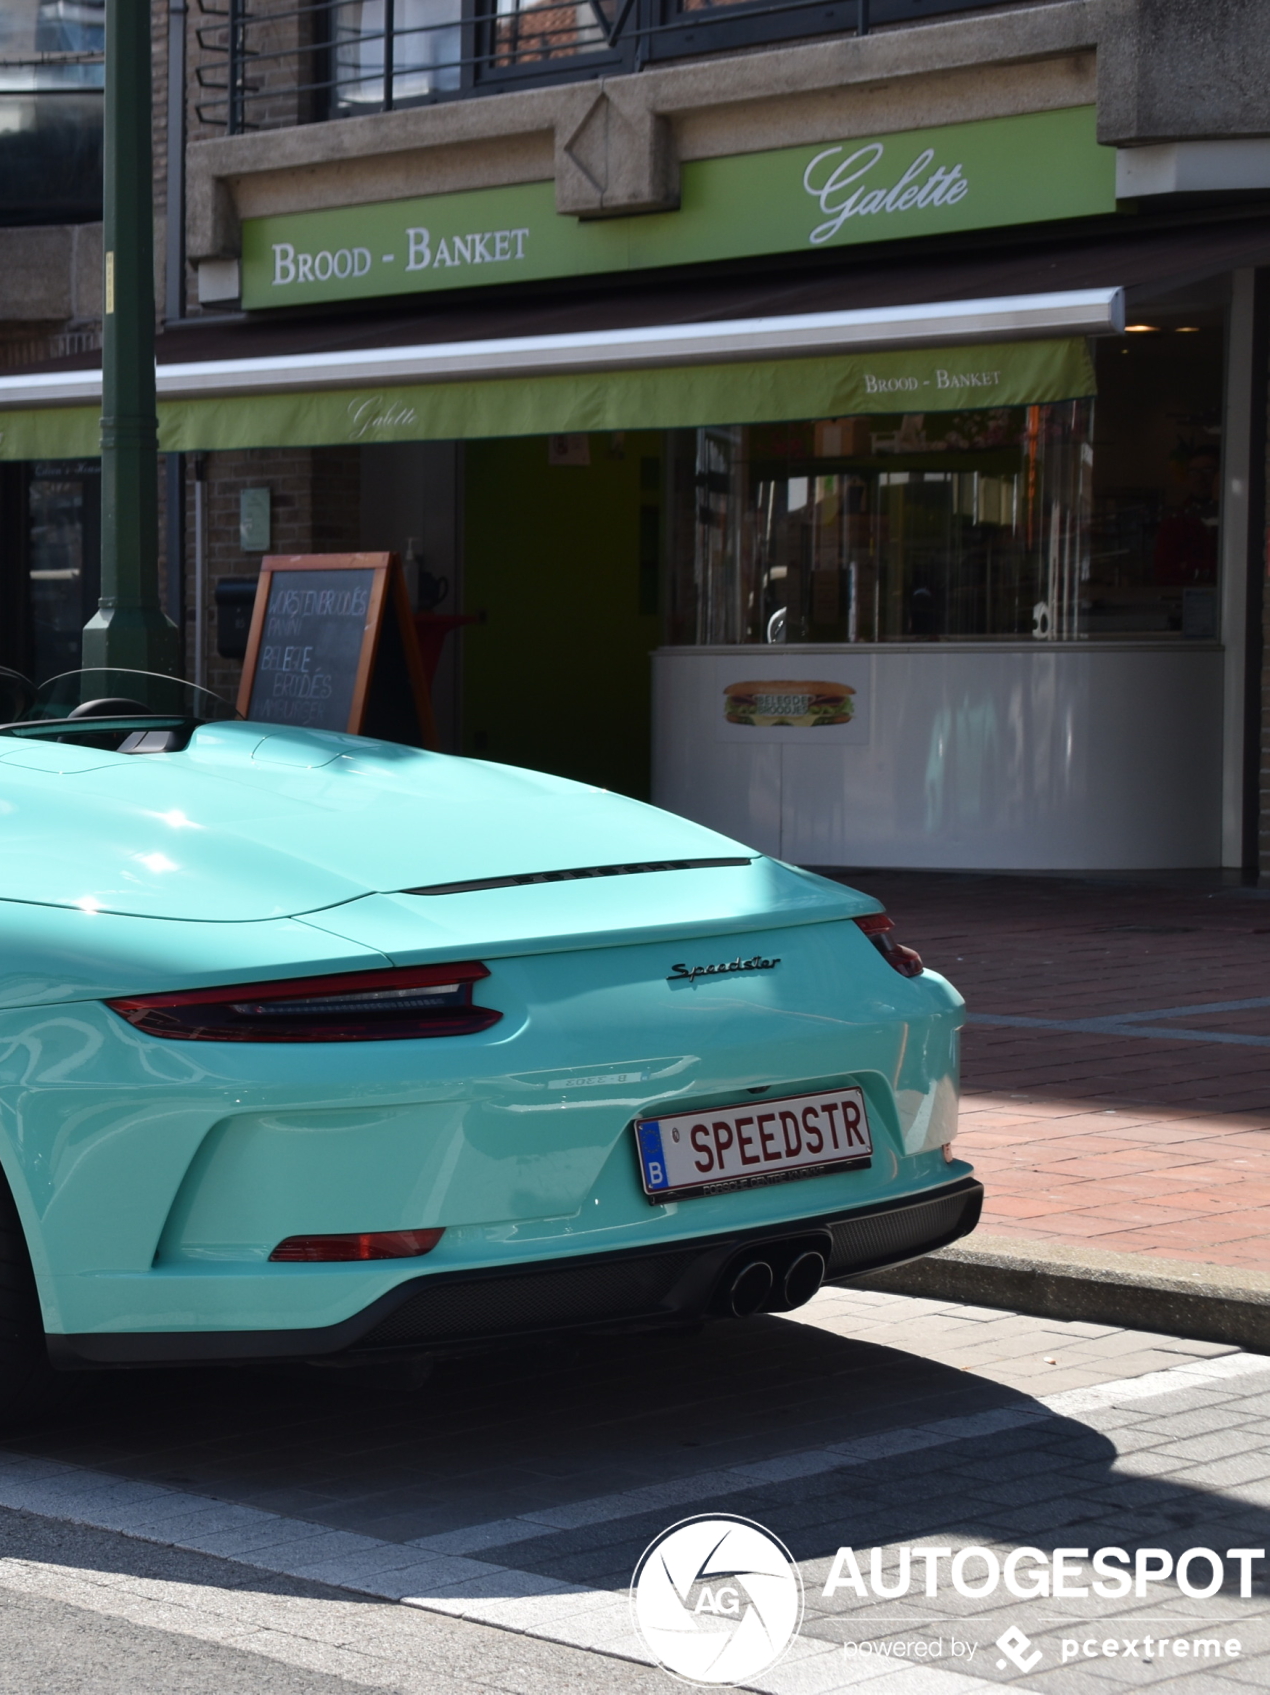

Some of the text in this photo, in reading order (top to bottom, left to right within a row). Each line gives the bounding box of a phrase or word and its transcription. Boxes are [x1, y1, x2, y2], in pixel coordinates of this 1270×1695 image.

[803, 143, 968, 244] Galette
[405, 227, 529, 271] BANKET
[347, 395, 418, 440] Galette
[758, 695, 808, 706] BELEGDE
[666, 955, 781, 982] Speedster
[648, 1100, 866, 1184] B SPEEDSTR
[703, 1179, 748, 1196] PORSCHE
